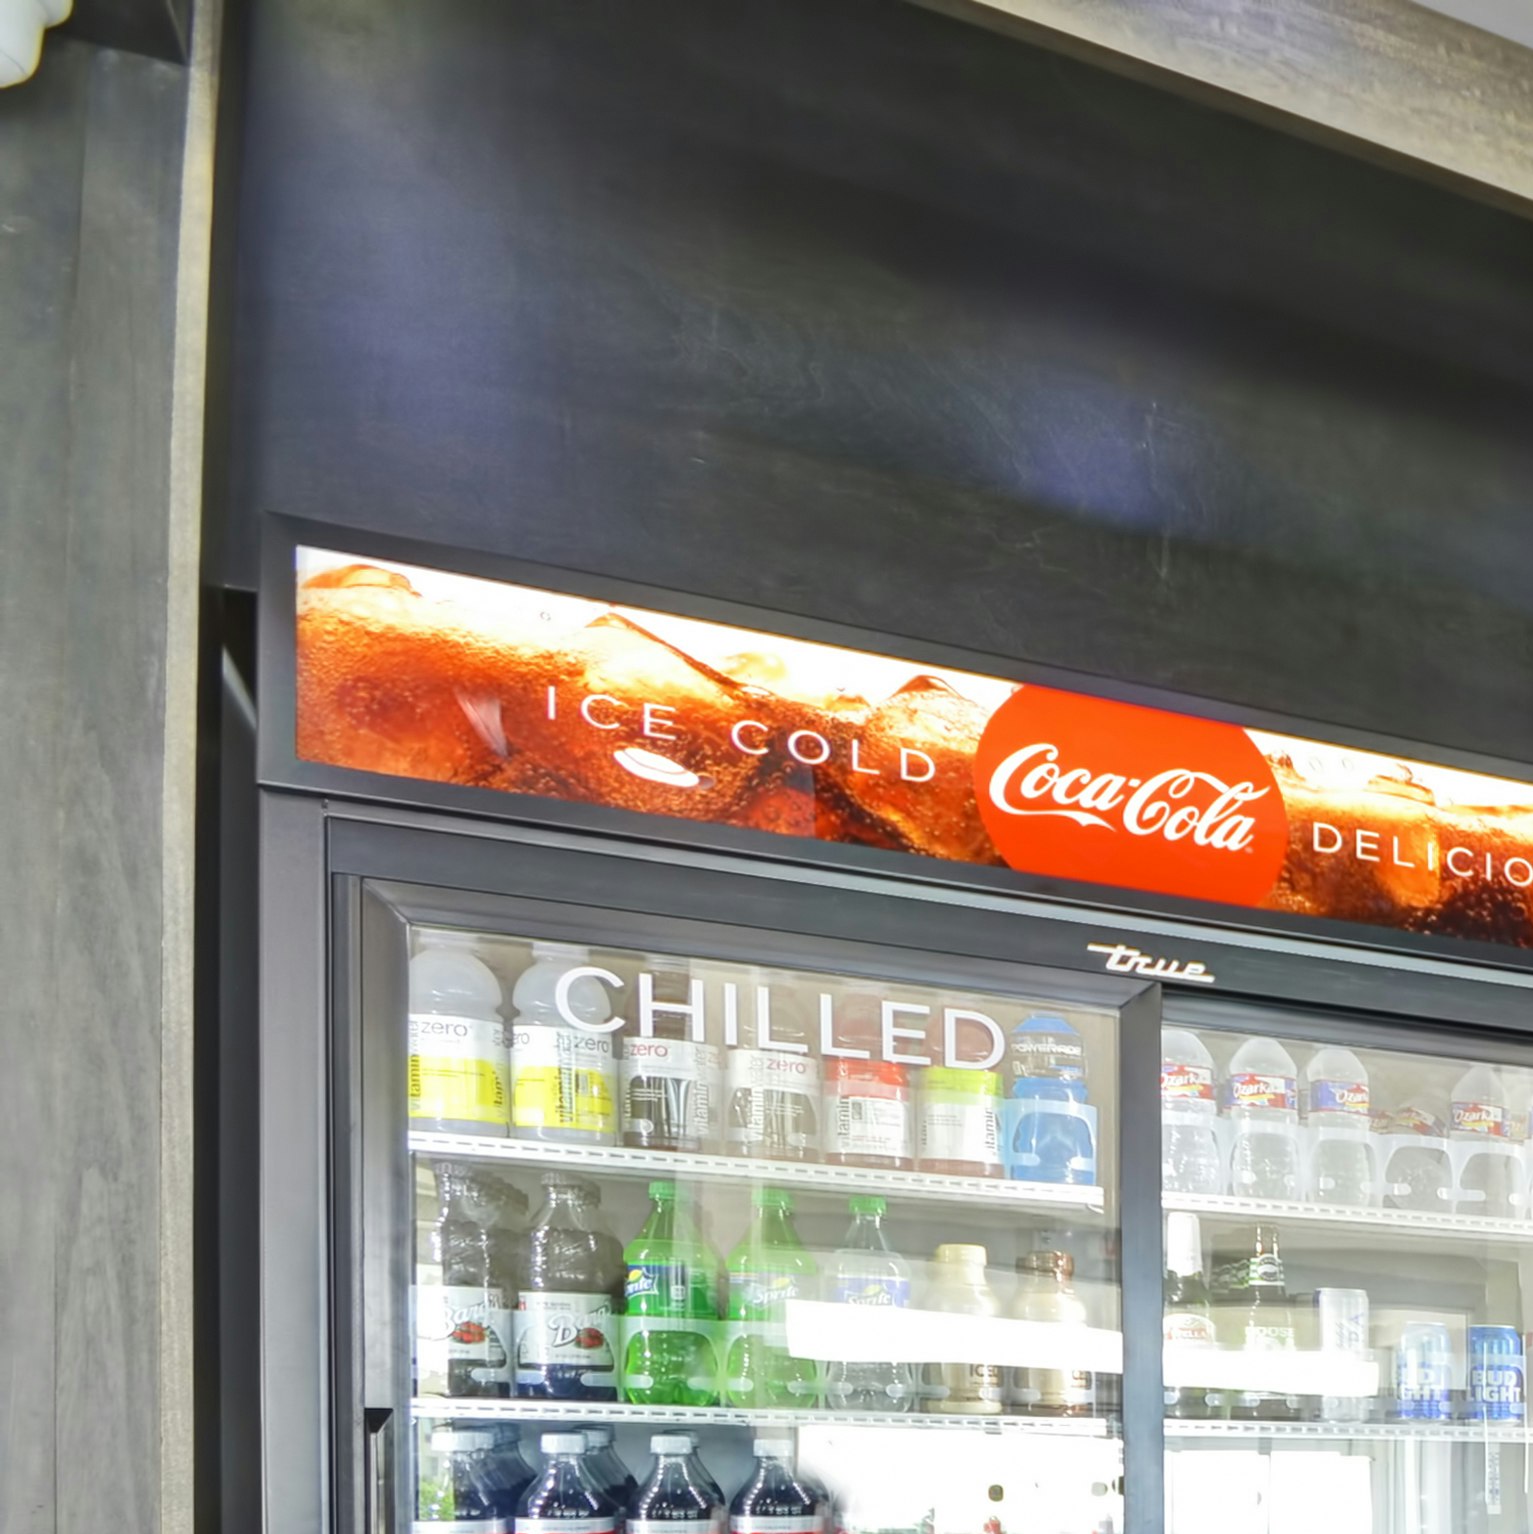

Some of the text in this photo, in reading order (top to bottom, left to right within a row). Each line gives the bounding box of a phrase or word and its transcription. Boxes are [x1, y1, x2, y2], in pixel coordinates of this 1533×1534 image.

[546, 685, 936, 783] ICE COLD
[989, 743, 1271, 853] Coca-Cola
[555, 966, 1006, 1070] CHILLED
[421, 1019, 468, 1038] zero
[573, 1035, 609, 1054] zero
[630, 1042, 668, 1059] zero
[766, 1057, 806, 1075] zero
[755, 1284, 799, 1305] Sprite
[1472, 1369, 1518, 1386] BUD
